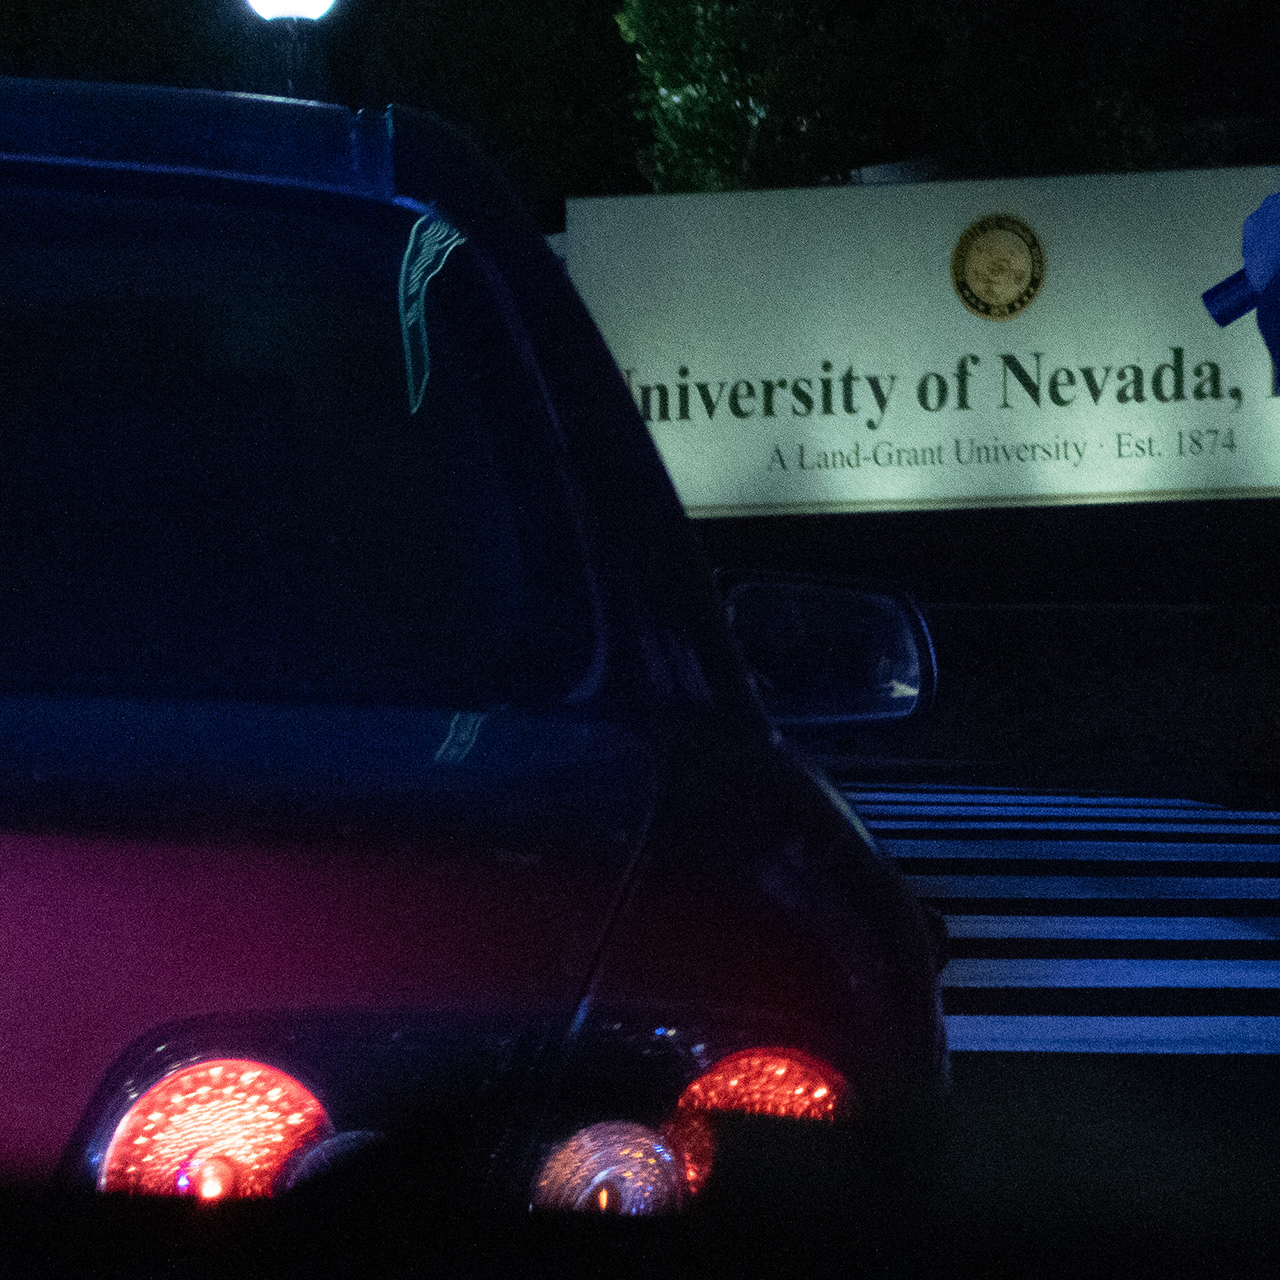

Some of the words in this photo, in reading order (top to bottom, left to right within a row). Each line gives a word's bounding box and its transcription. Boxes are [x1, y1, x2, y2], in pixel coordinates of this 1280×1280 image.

[623, 359, 896, 429] niversity
[916, 352, 981, 413] of
[998, 345, 1244, 410] Nevada,
[767, 445, 789, 472] A
[797, 439, 945, 471] Land-Grant
[954, 434, 1088, 468] University
[1116, 431, 1163, 459] Est.
[1176, 427, 1238, 457] 1874
